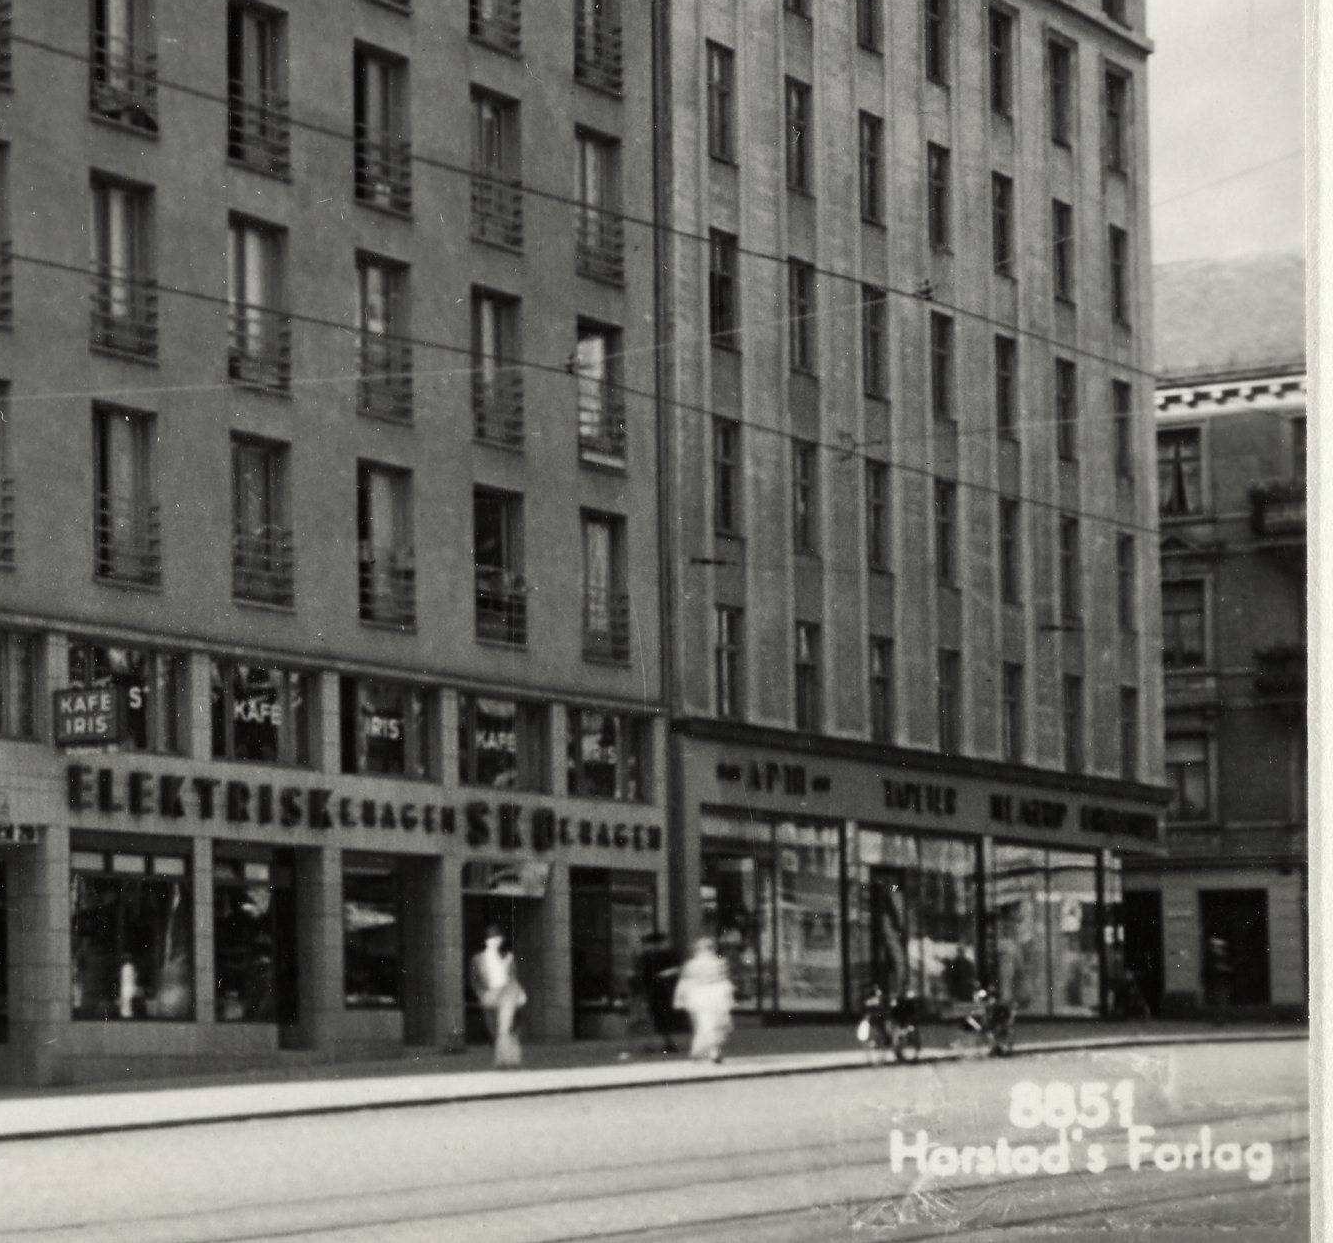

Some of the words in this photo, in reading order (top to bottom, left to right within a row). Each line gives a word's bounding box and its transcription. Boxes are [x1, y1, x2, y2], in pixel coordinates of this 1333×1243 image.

[60, 692, 112, 713] KAFE
[66, 716, 108, 735] IRIS
[67, 764, 333, 829] ELEKTRISK
